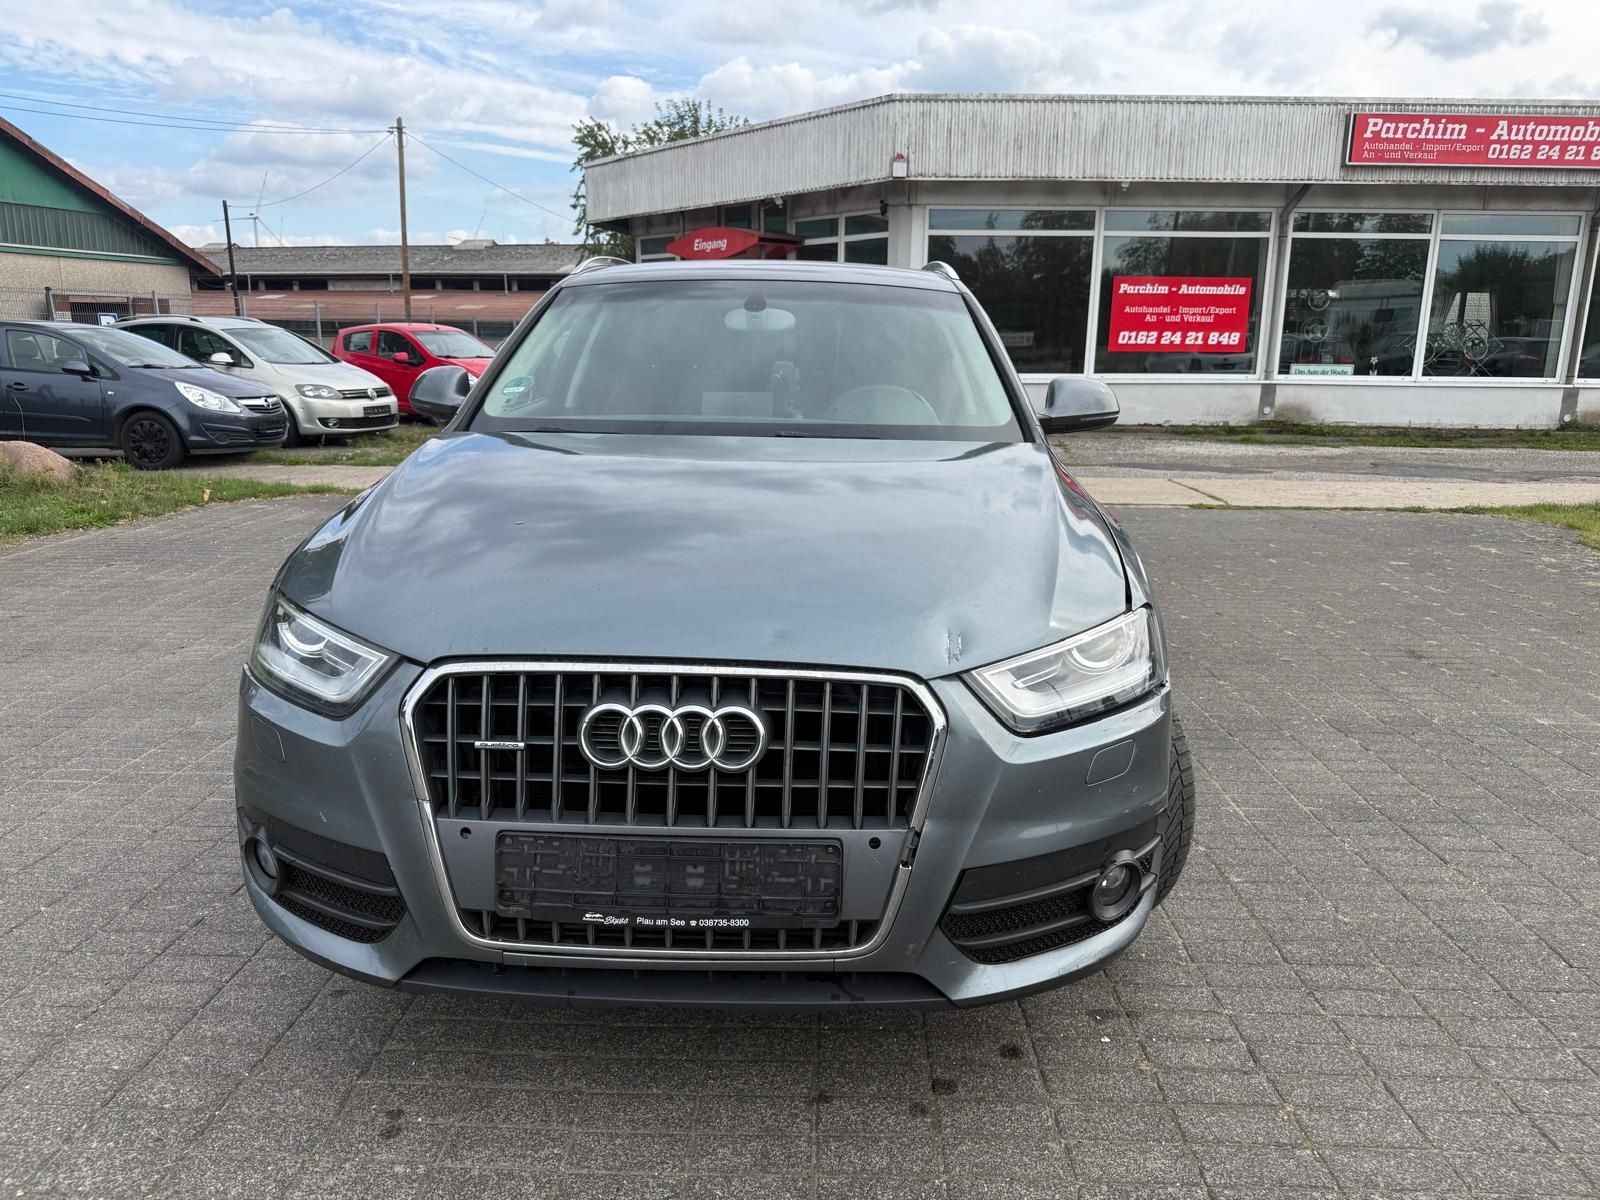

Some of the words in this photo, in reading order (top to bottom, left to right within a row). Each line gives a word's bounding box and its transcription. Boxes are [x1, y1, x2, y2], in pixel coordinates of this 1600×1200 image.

[1363, 118, 1467, 139] Parchim
[1490, 120, 1600, 142] Automob
[1363, 142, 1413, 150] Autohandel
[1422, 143, 1484, 152] Import/Export
[1488, 144, 1531, 159] 0162
[1536, 145, 1560, 160] 24
[1564, 145, 1586, 160] 21
[1362, 151, 1375, 159] An
[1384, 151, 1401, 159] und
[1404, 151, 1438, 160] Verkauf
[693, 238, 727, 252] Eingang
[1118, 283, 1169, 294] Parchim
[1178, 284, 1246, 295] Automobile
[1124, 306, 1171, 314] Autohandel
[1178, 306, 1237, 315] Import/Export
[1145, 314, 1157, 322] An
[1165, 314, 1181, 322] und
[1183, 314, 1215, 323] Verkauf
[1118, 331, 1158, 344] 0162
[1160, 331, 1182, 345] 24
[1185, 331, 1204, 345] 21
[1208, 332, 1241, 345] 848
[636, 917, 654, 925] Plau
[670, 918, 686, 926] See
[699, 919, 749, 927] 038735-8300
